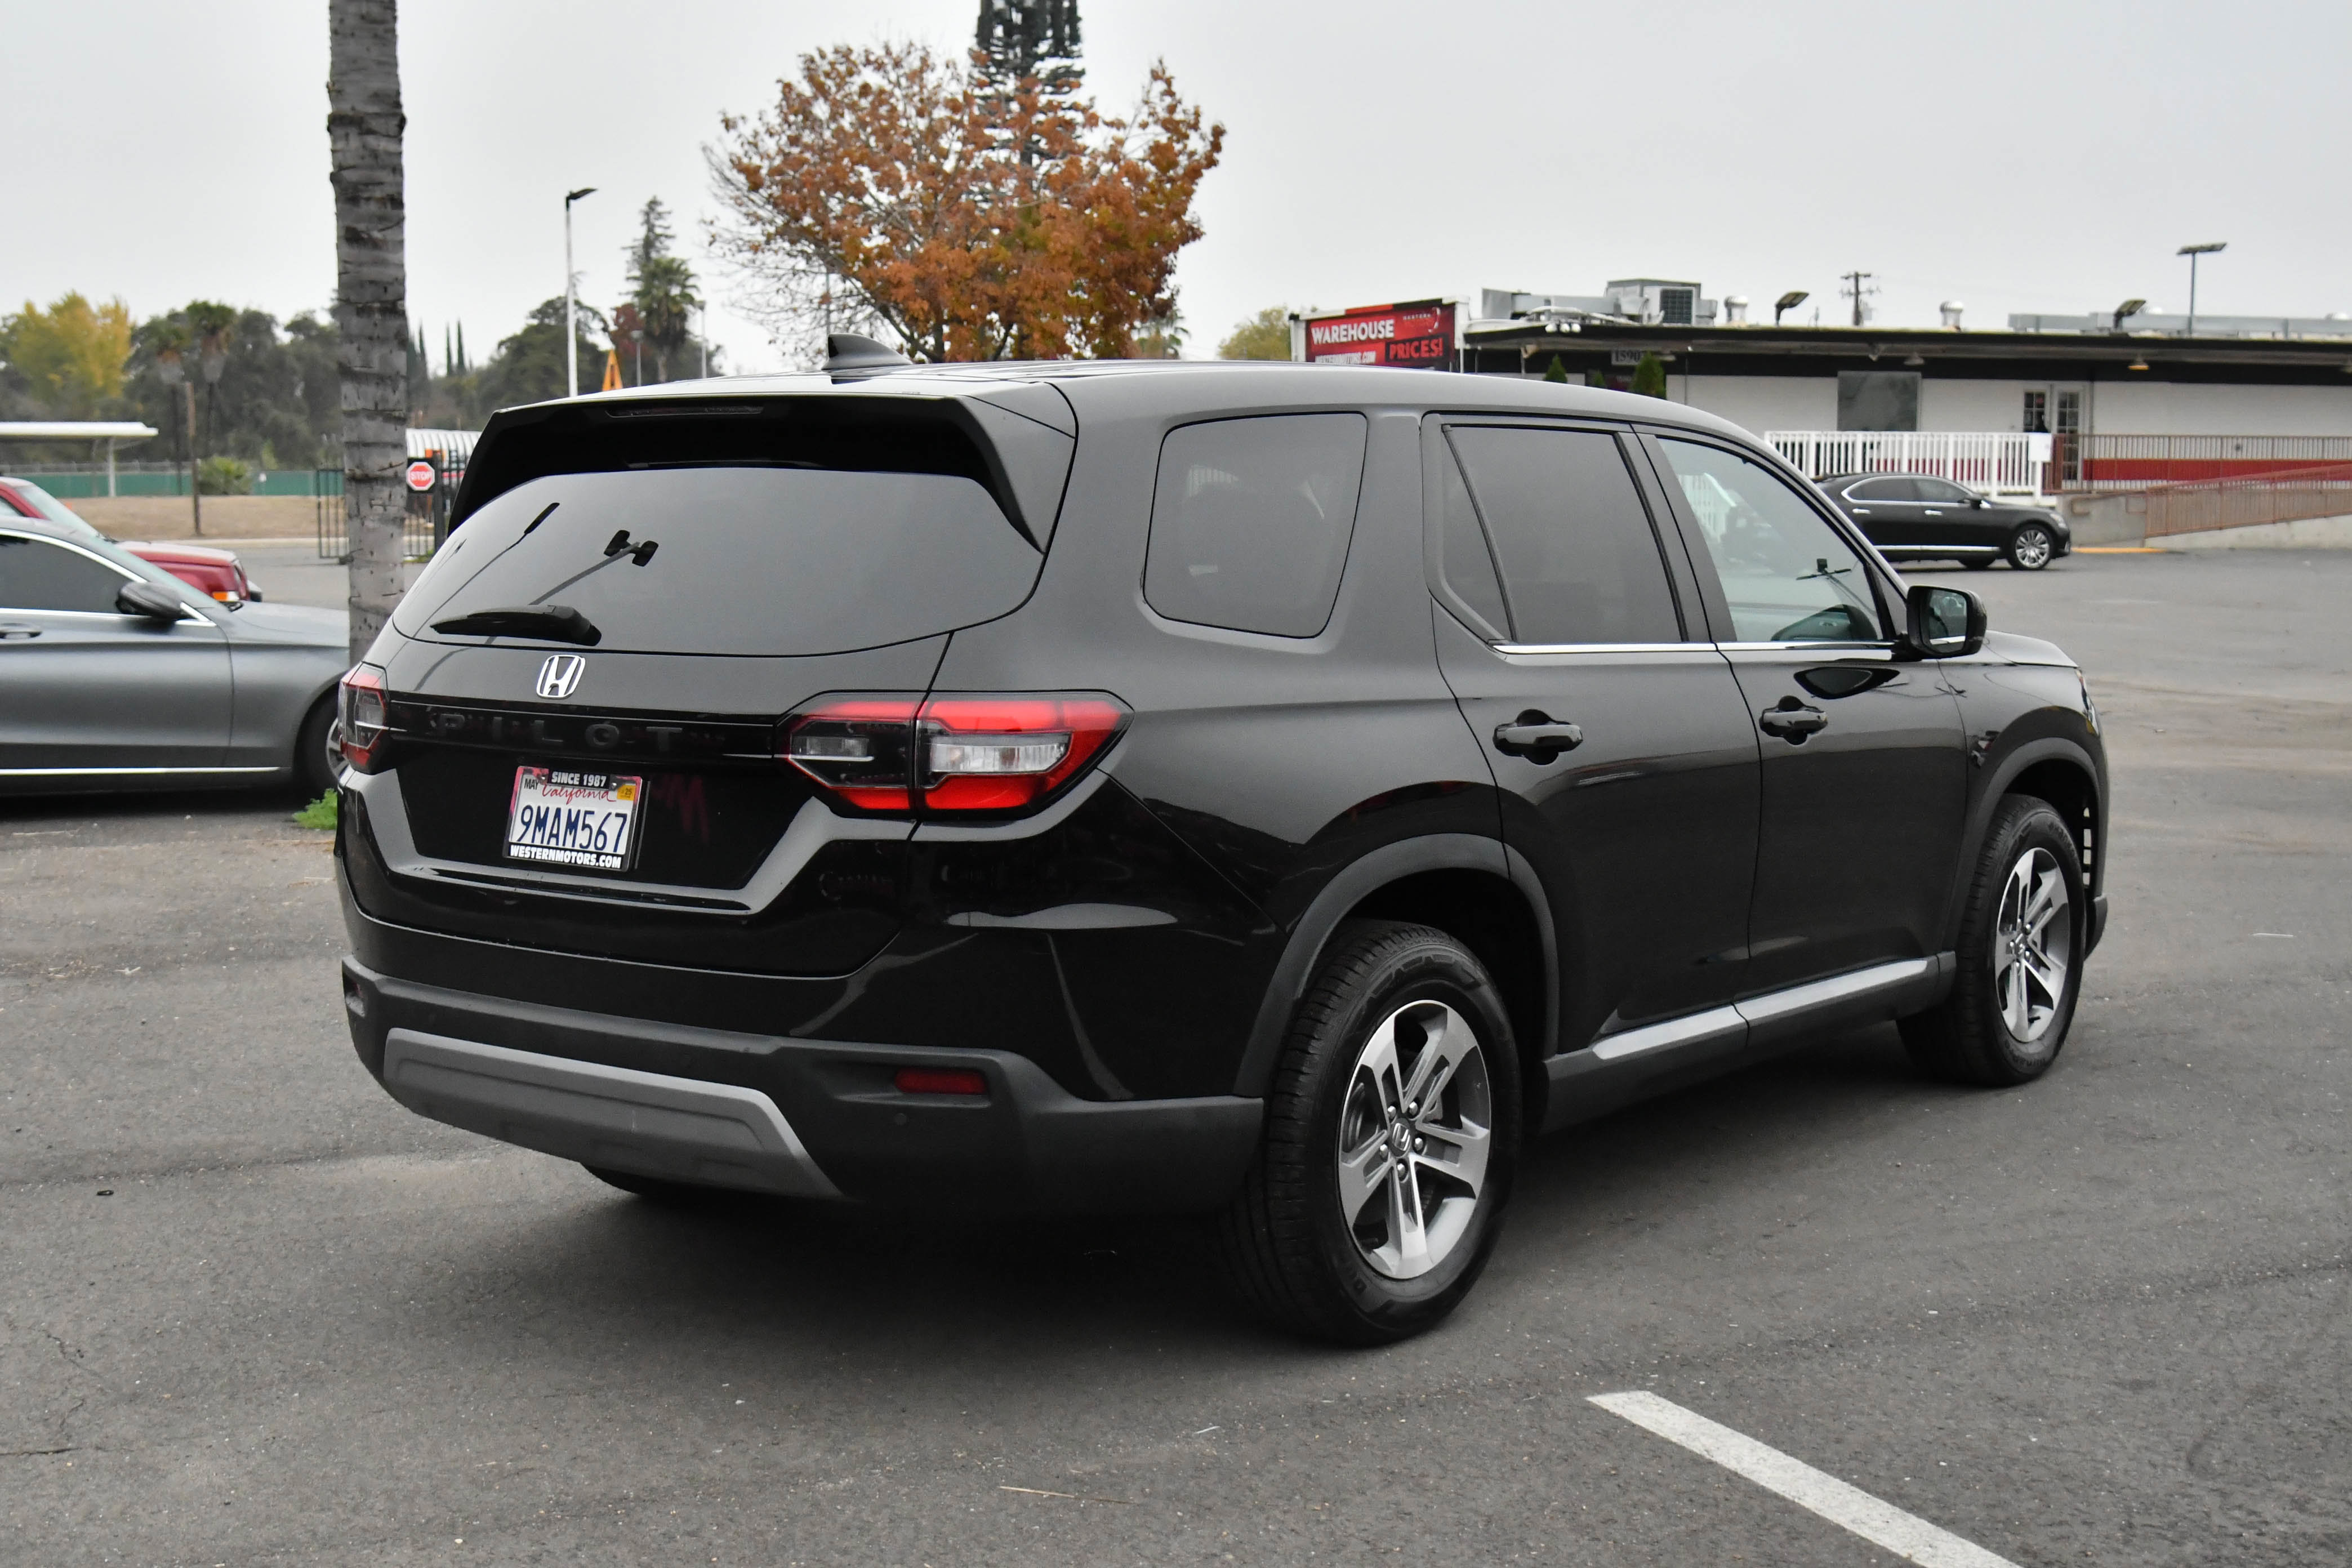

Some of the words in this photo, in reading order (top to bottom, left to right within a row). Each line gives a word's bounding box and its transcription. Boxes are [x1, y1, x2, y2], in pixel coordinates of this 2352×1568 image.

[1311, 319, 1395, 345] WAREHOUSE
[1389, 337, 1443, 360] PRICES!
[439, 713, 683, 751] PILOT
[524, 778, 539, 789] MAY
[551, 771, 580, 785] SINCE
[583, 775, 607, 787] 1987
[542, 784, 616, 805] California
[517, 805, 627, 853] 9MAM567
[510, 845, 622, 868] WESTERNMOTORS.COM
